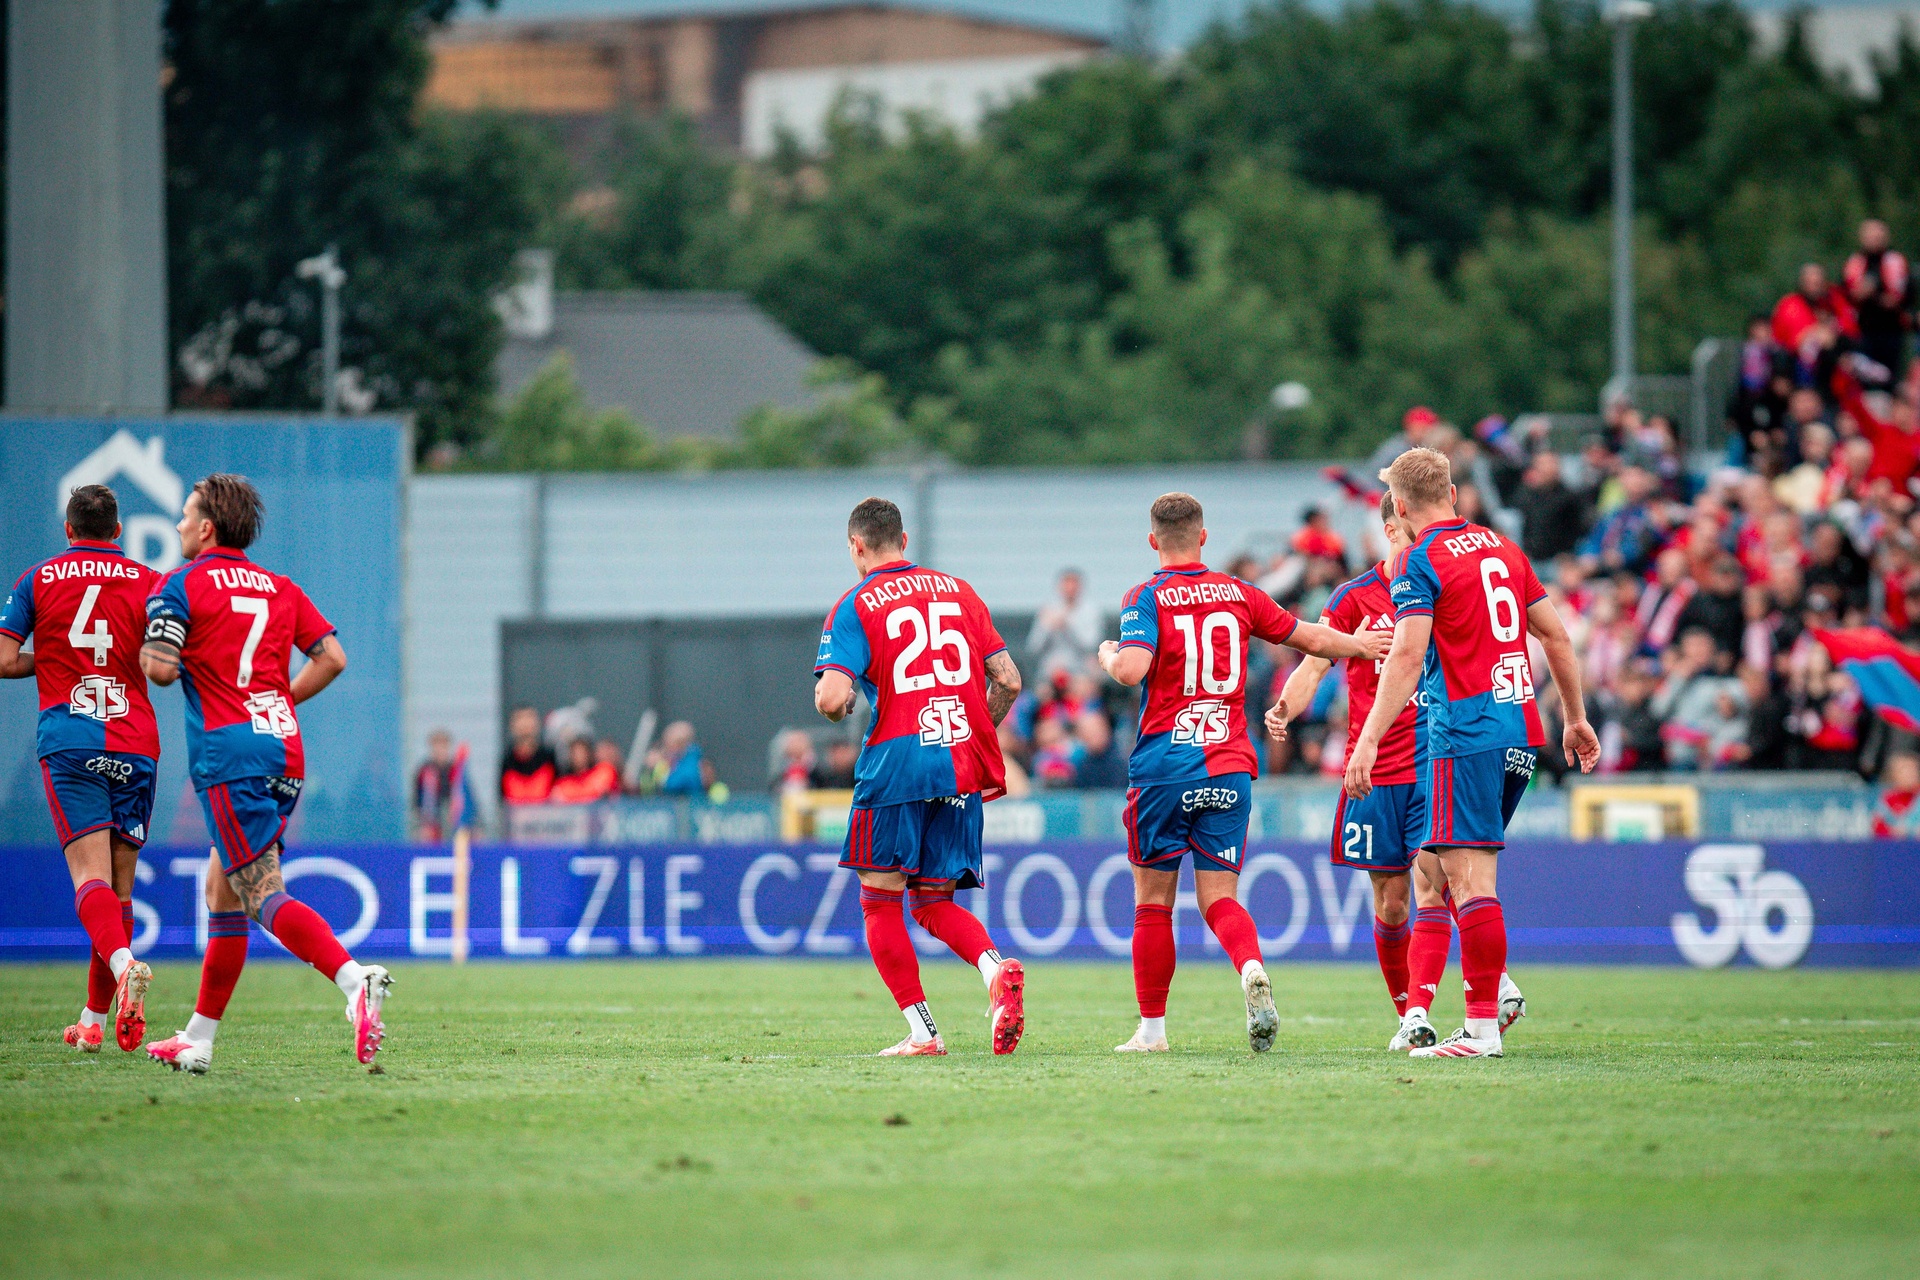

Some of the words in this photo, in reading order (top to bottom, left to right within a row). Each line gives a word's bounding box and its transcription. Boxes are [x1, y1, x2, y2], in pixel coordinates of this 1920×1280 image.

[1443, 530, 1504, 558] REPKA
[41, 560, 140, 583] SVARNAS
[207, 567, 277, 594] TUDOR
[1155, 582, 1246, 607] KOCHERGIN
[1480, 556, 1520, 643] 6
[68, 585, 113, 667] 4
[230, 595, 269, 688] 7
[886, 601, 970, 694] 25
[1173, 611, 1240, 697] 10
[70, 674, 129, 721] STS
[918, 695, 972, 747] STS
[1171, 700, 1231, 746] STS
[1344, 822, 1373, 859] 21
